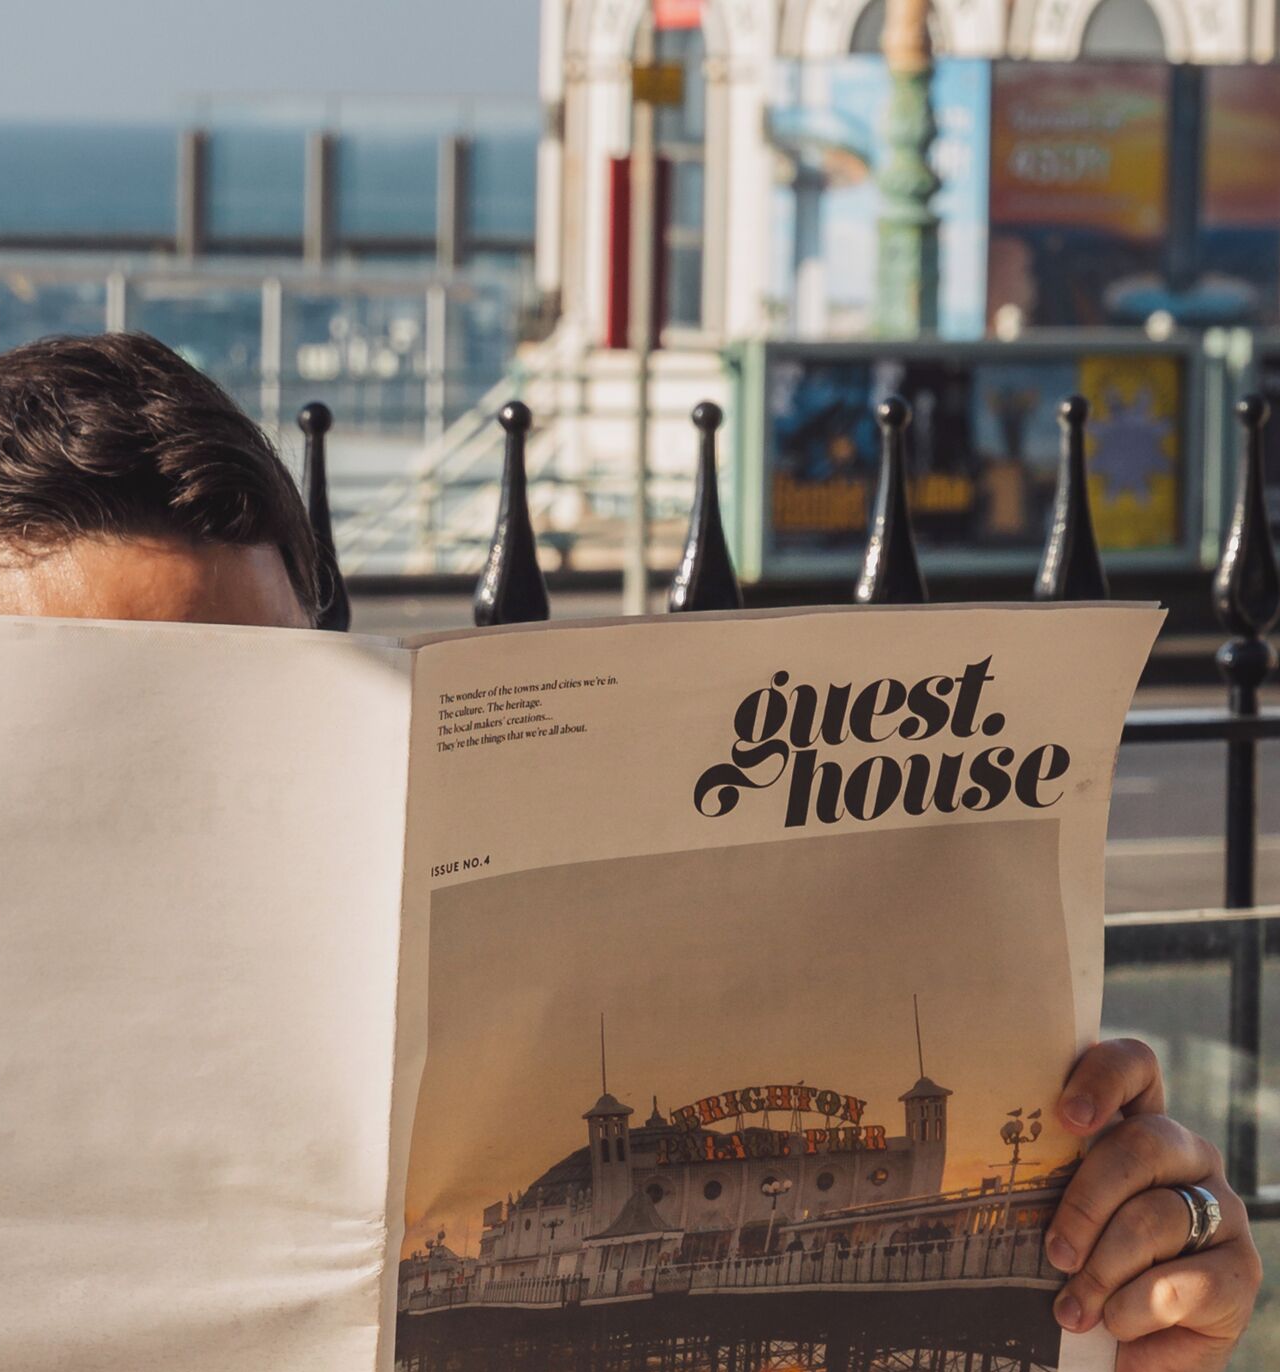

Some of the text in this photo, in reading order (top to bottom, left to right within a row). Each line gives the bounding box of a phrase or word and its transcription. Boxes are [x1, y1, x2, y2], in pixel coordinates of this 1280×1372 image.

[440, 676, 618, 704] The wonder of the towns and cities we're in.
[439, 699, 542, 720] The culture. The heritage.
[437, 723, 587, 752] They're the things that we're all about.
[438, 727, 452, 736] The
[454, 722, 472, 733] local
[694, 654, 1006, 818] guest.
[784, 743, 1071, 828] house
[431, 861, 460, 877] ISSUE
[671, 1085, 868, 1133] BRIGHTON
[656, 1125, 887, 1164] PALACE PIER
